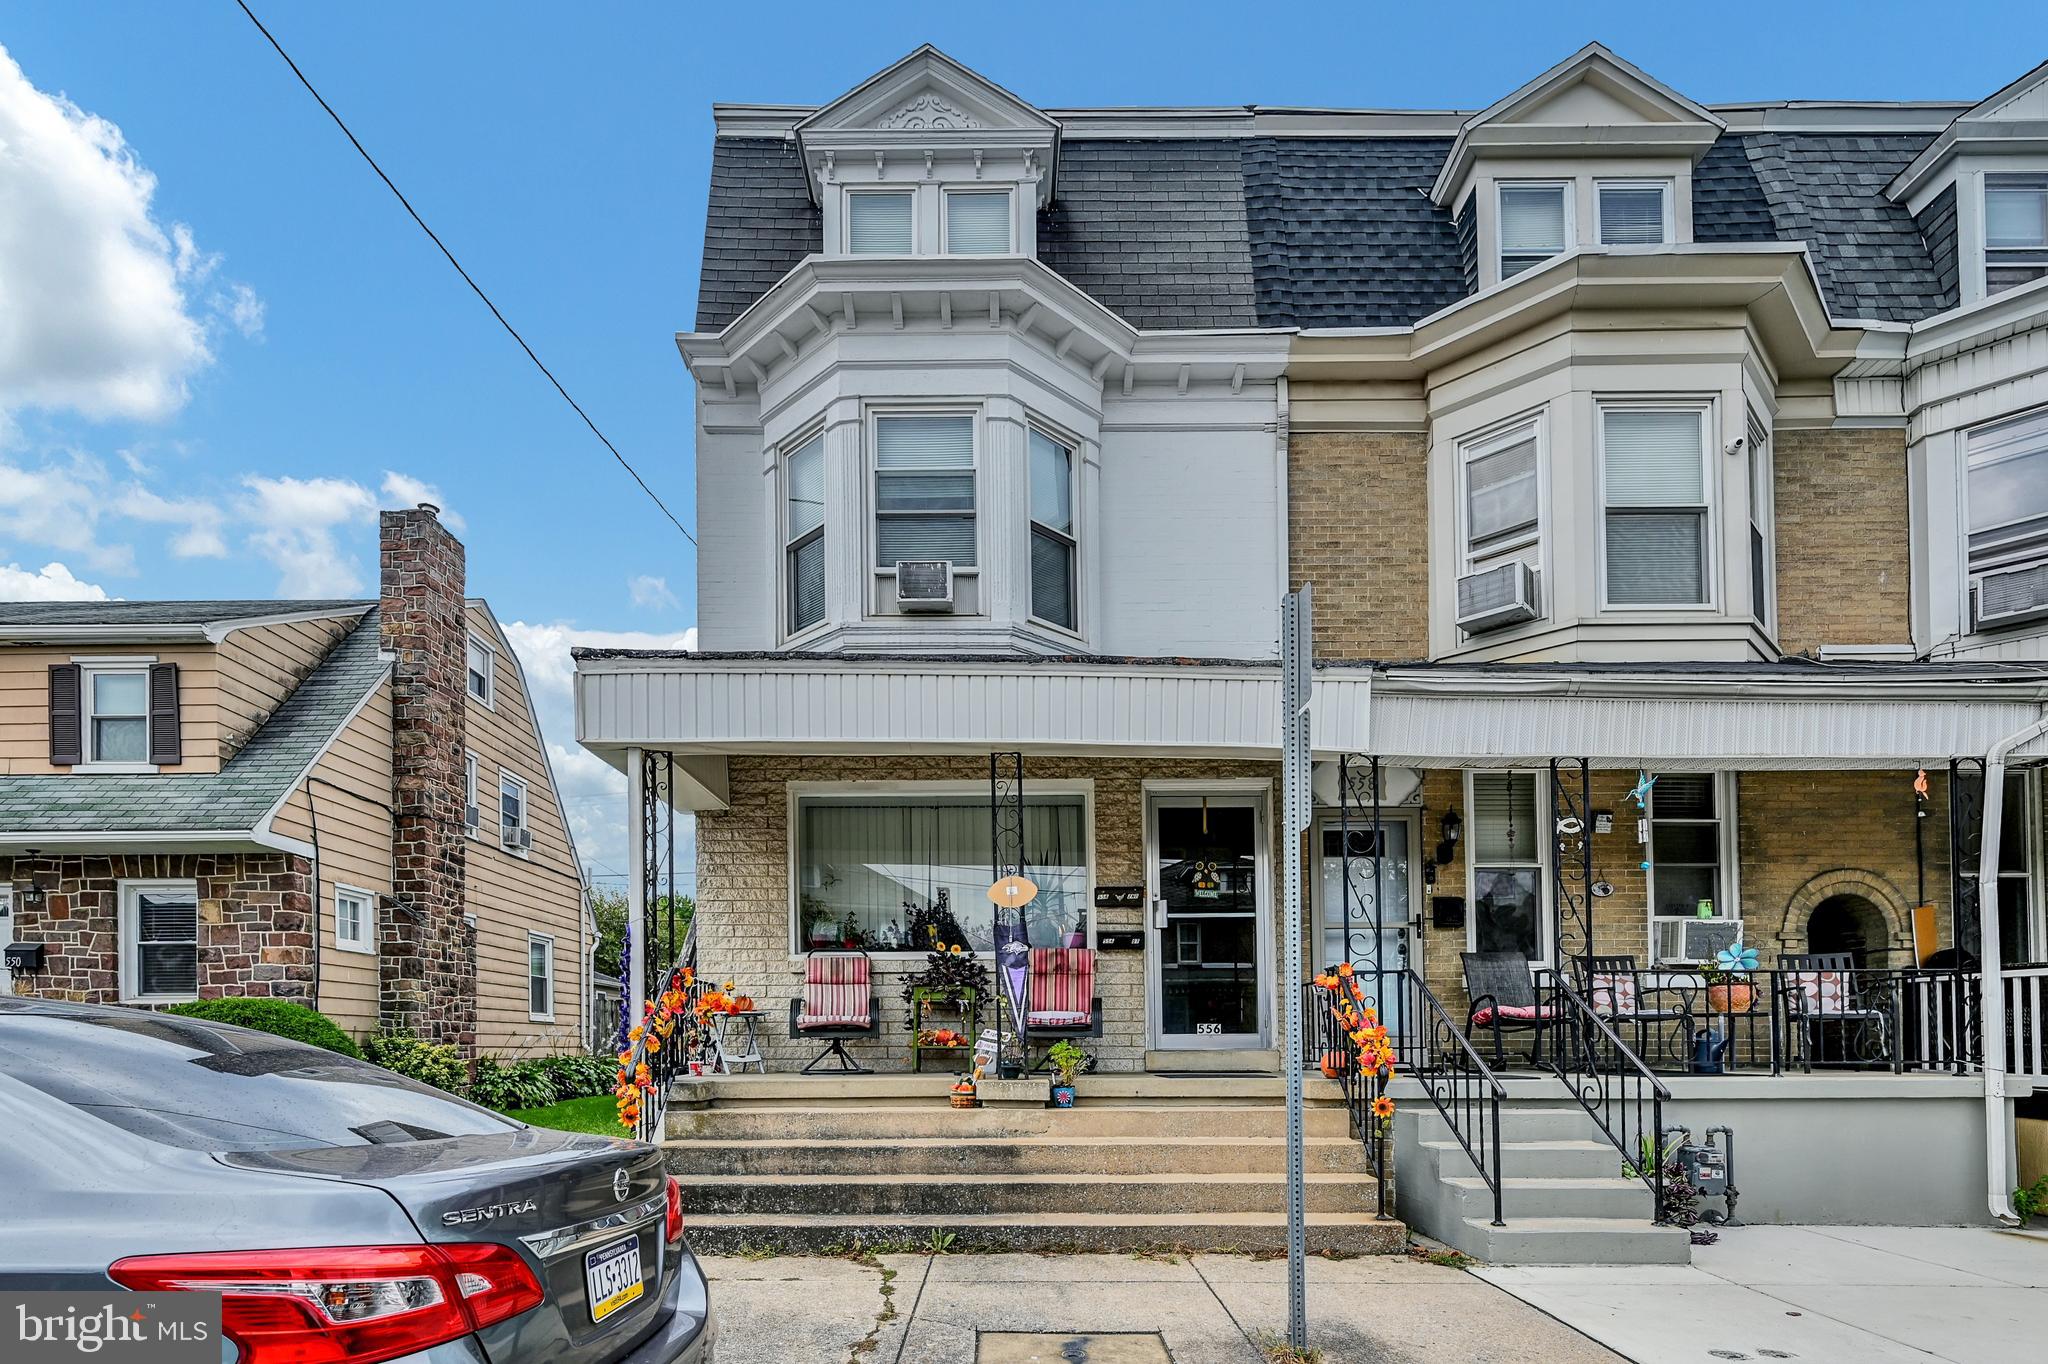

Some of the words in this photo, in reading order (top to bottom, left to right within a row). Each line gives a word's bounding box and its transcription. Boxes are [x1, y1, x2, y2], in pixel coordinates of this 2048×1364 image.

[5, 956, 21, 967] 550
[1198, 1023, 1221, 1034] 556
[442, 1199, 537, 1227] SENTRA
[599, 1244, 627, 1262] PENNSYLVANIA
